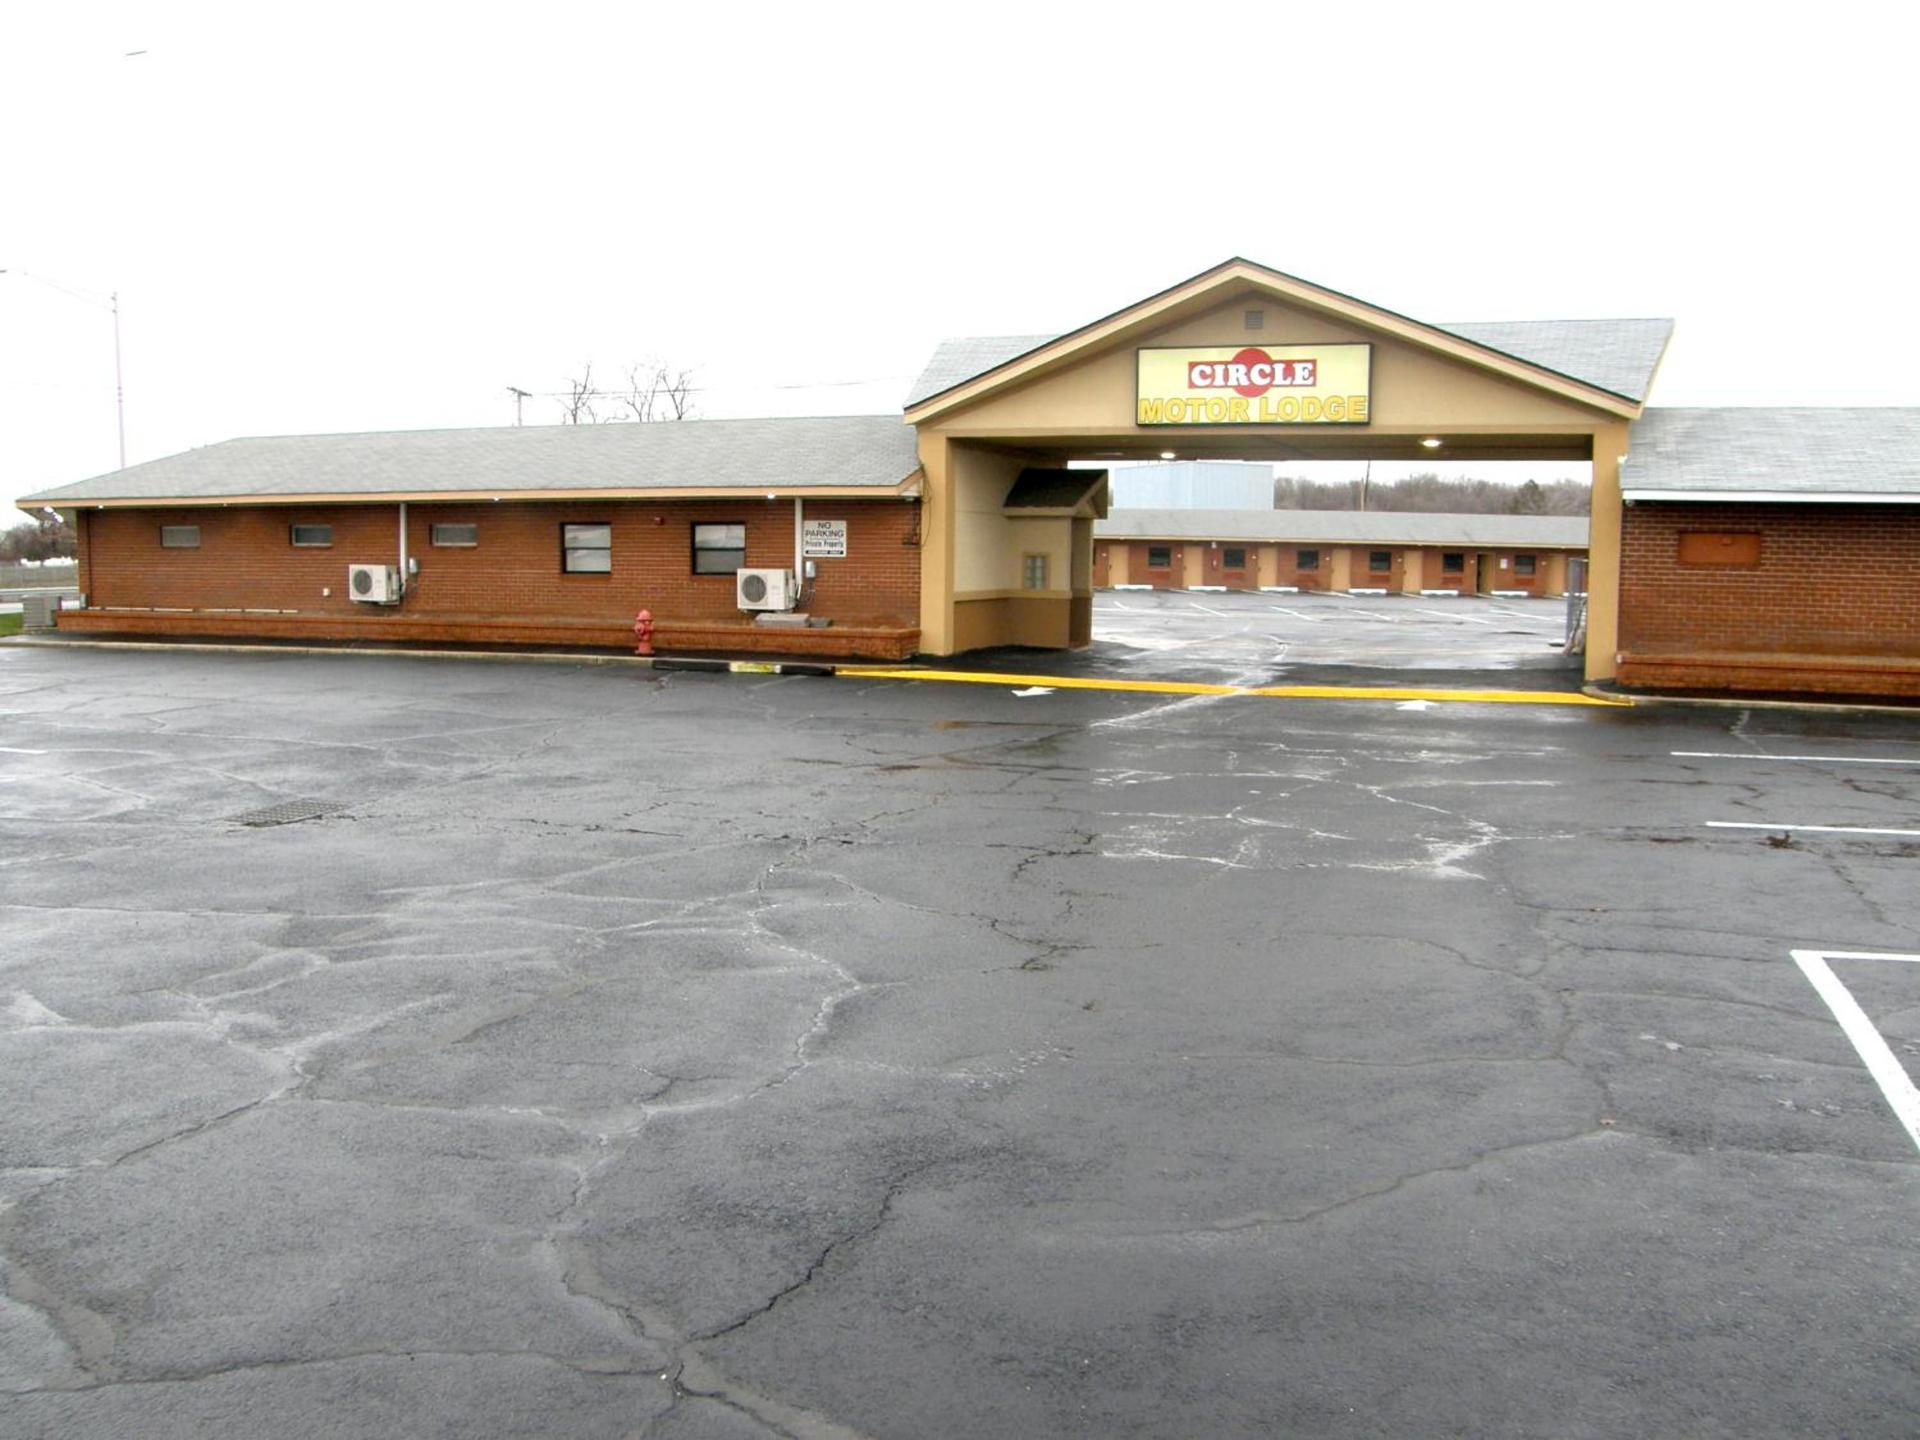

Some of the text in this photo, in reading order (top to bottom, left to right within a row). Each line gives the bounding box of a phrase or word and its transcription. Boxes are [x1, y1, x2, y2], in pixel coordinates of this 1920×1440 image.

[1190, 363, 1314, 386] CIRCLE
[1139, 395, 1367, 423] MOTOR LODGE
[817, 521, 831, 529] NO
[805, 529, 844, 537] PARKING
